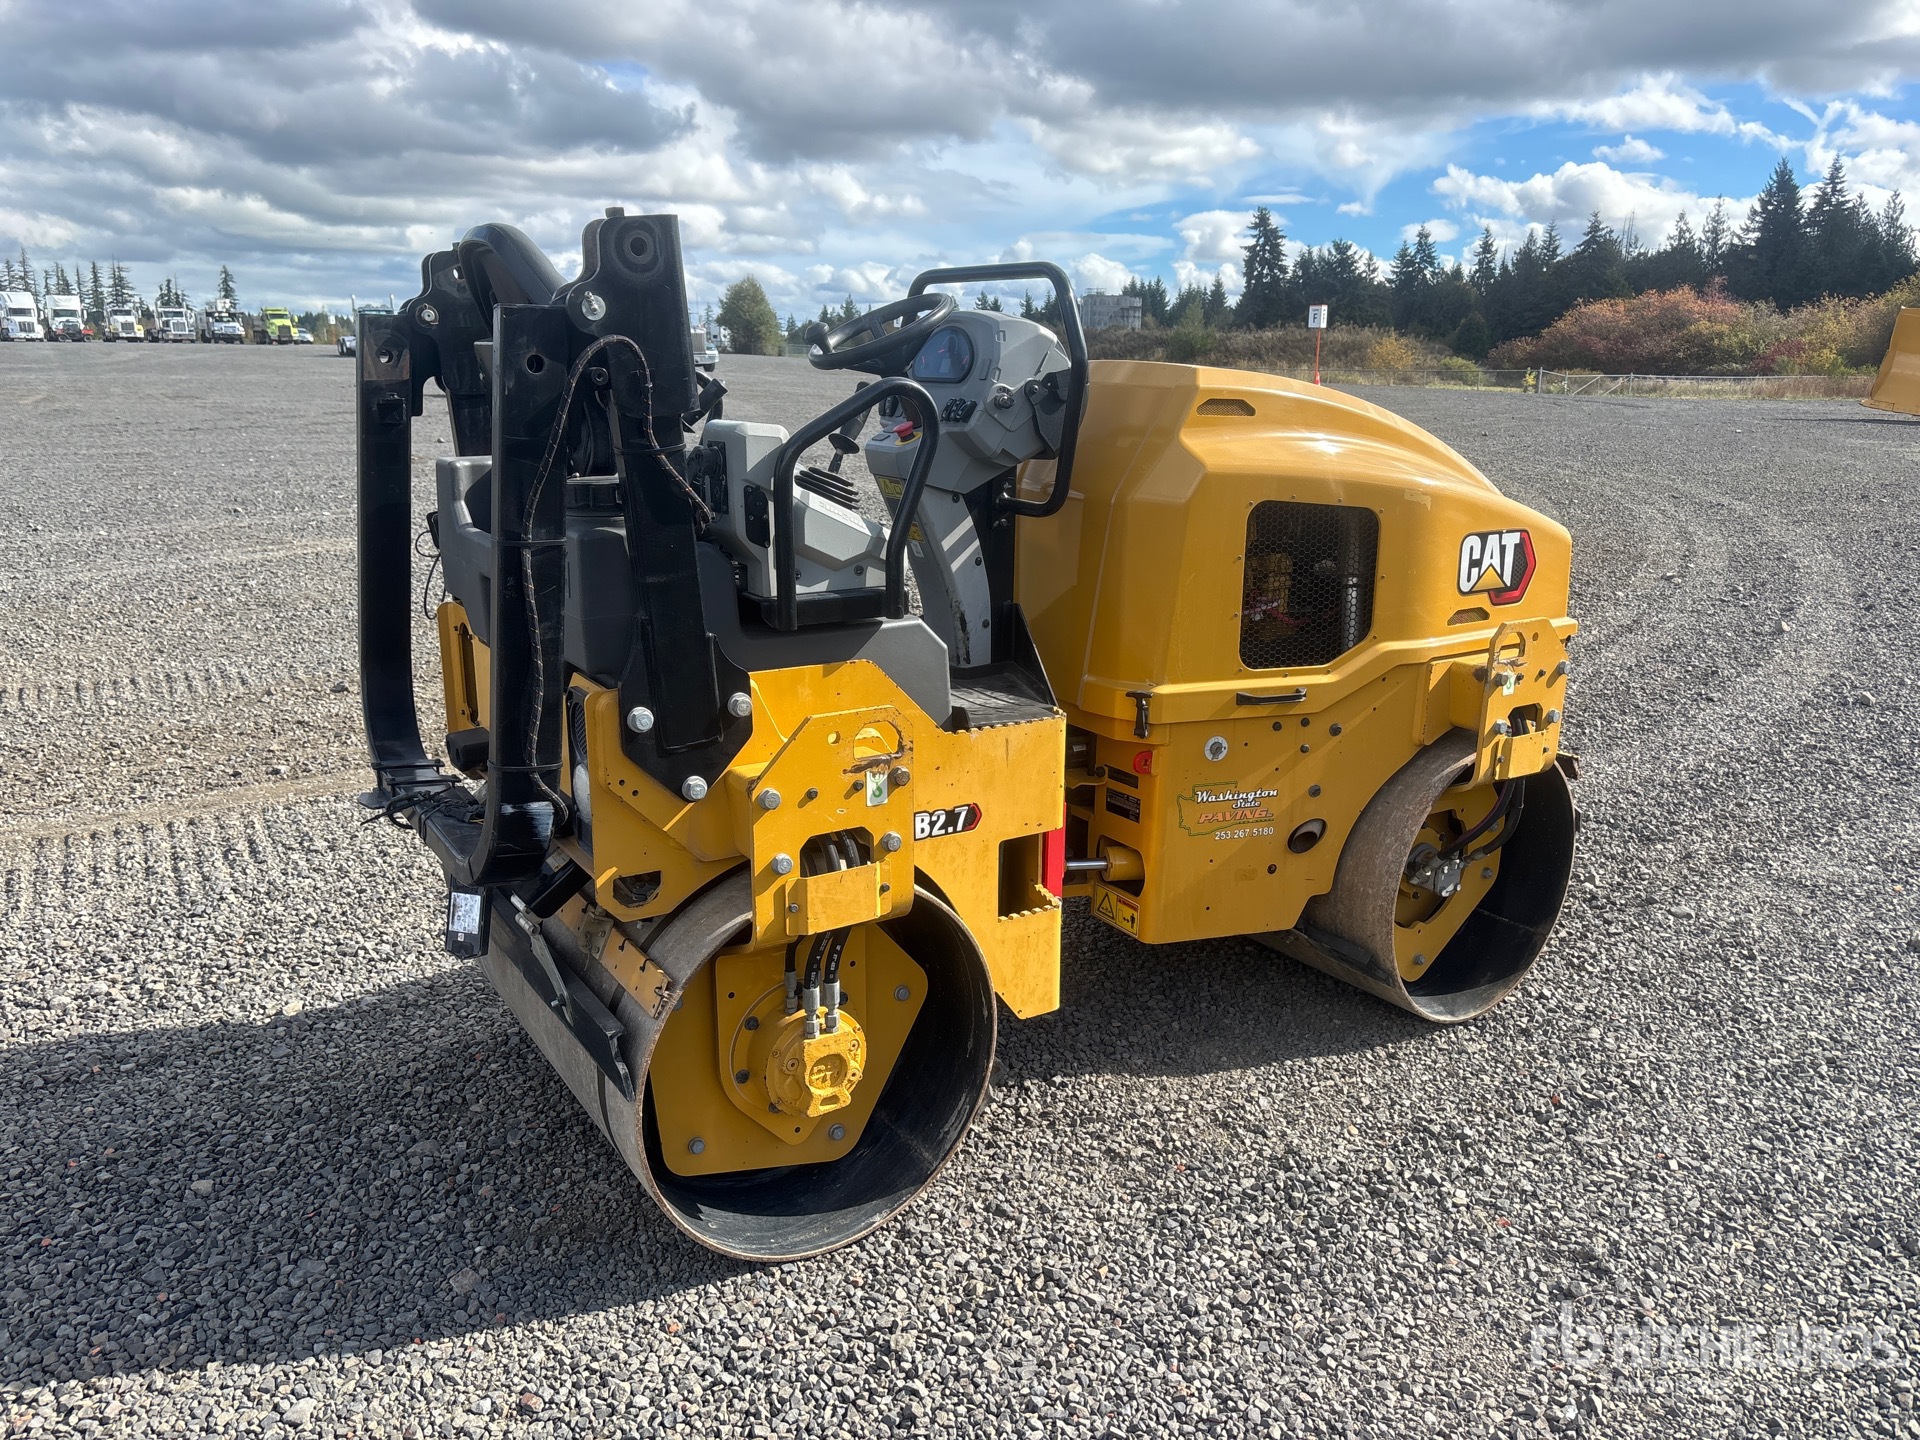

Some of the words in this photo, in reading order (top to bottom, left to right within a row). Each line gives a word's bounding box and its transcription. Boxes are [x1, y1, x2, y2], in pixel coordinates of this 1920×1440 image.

[1313, 313, 1318, 323] F
[1459, 531, 1521, 593] CAT
[1196, 788, 1278, 802] Washington
[1232, 799, 1261, 809] State
[914, 805, 969, 840] B2.7
[1198, 808, 1268, 823] PAVING
[1214, 826, 1275, 841] 253.267.5180
